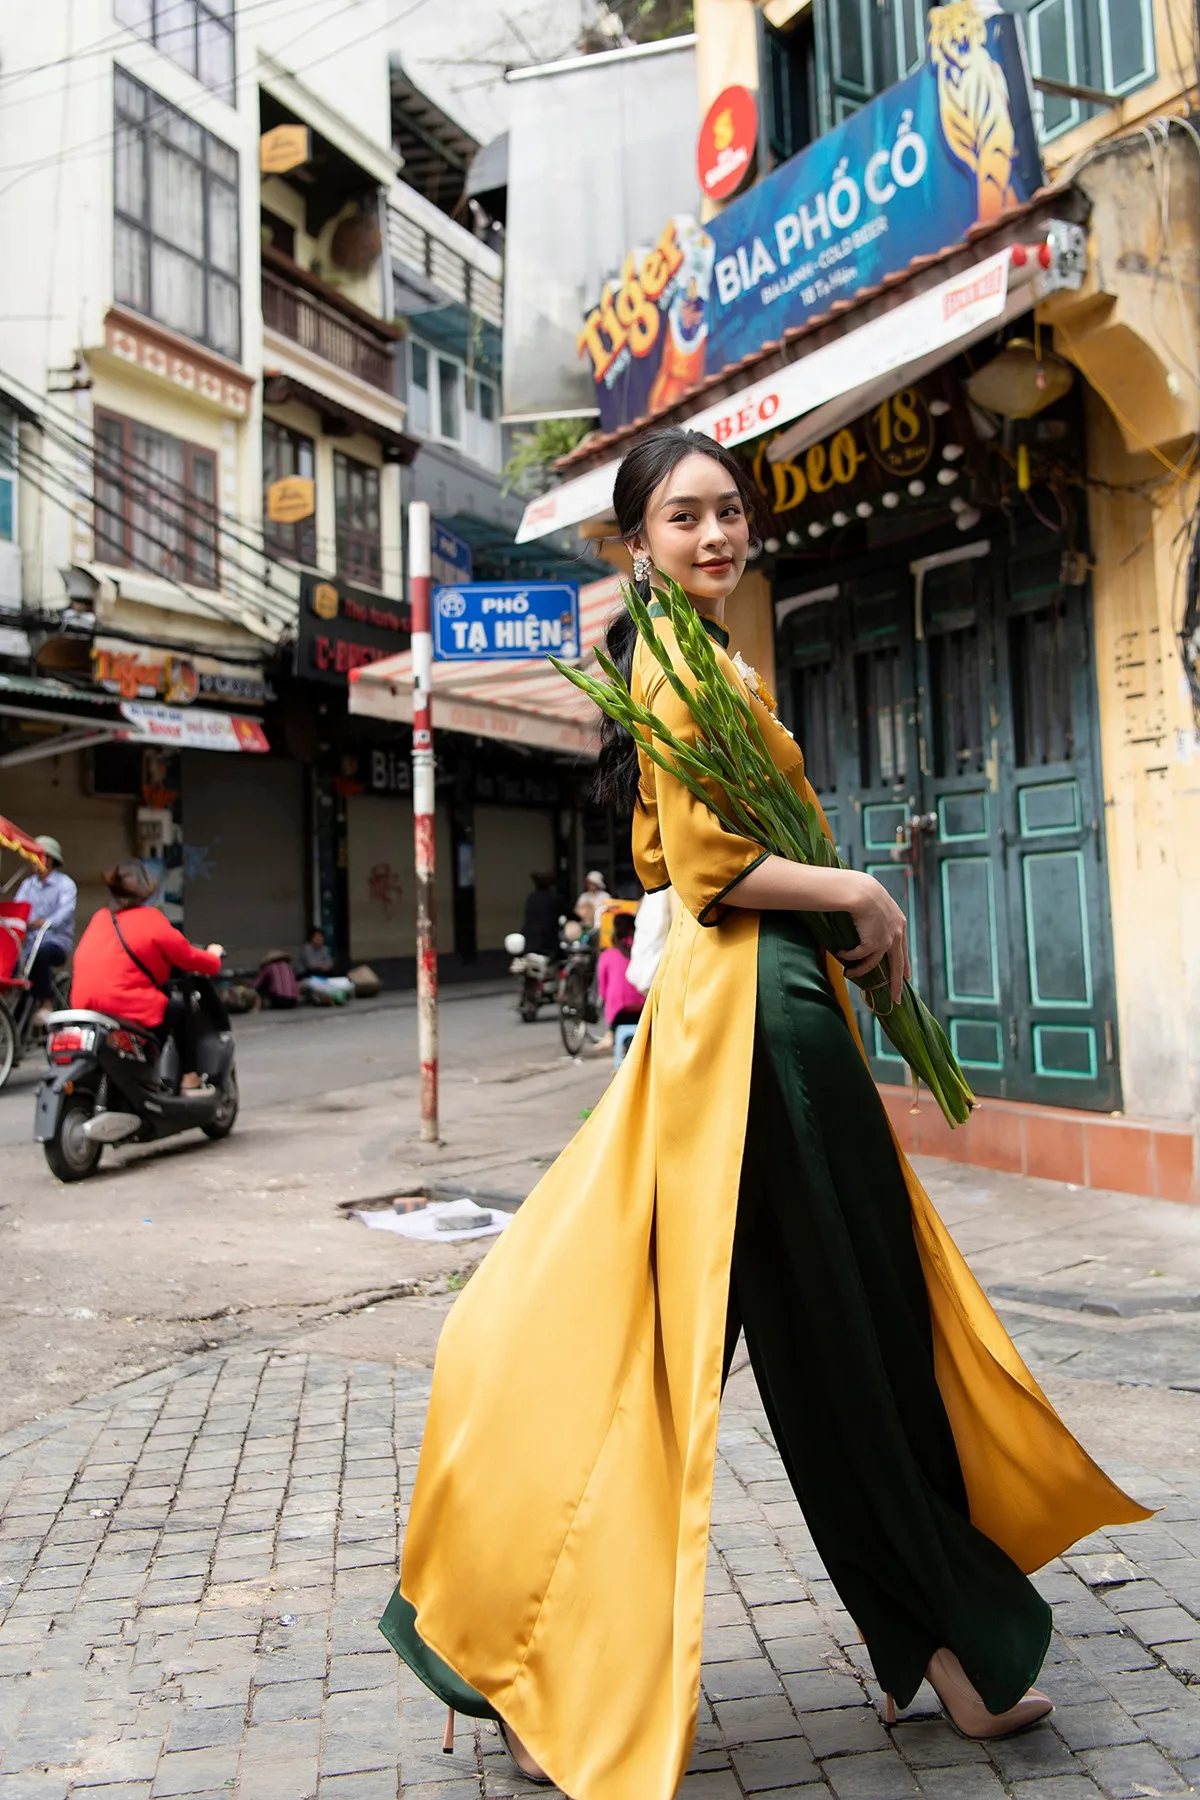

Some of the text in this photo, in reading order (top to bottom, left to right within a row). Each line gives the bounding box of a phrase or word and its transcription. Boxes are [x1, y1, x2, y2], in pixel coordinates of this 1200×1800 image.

[714, 108, 928, 305] BIA PHỐ CỔ
[576, 218, 685, 383] Tiger
[873, 390, 920, 451] 18
[481, 592, 530, 614] PHỐ
[451, 614, 562, 653] TẠ HIỆN
[90, 649, 165, 698] Tiger
[372, 750, 411, 790] Bia
